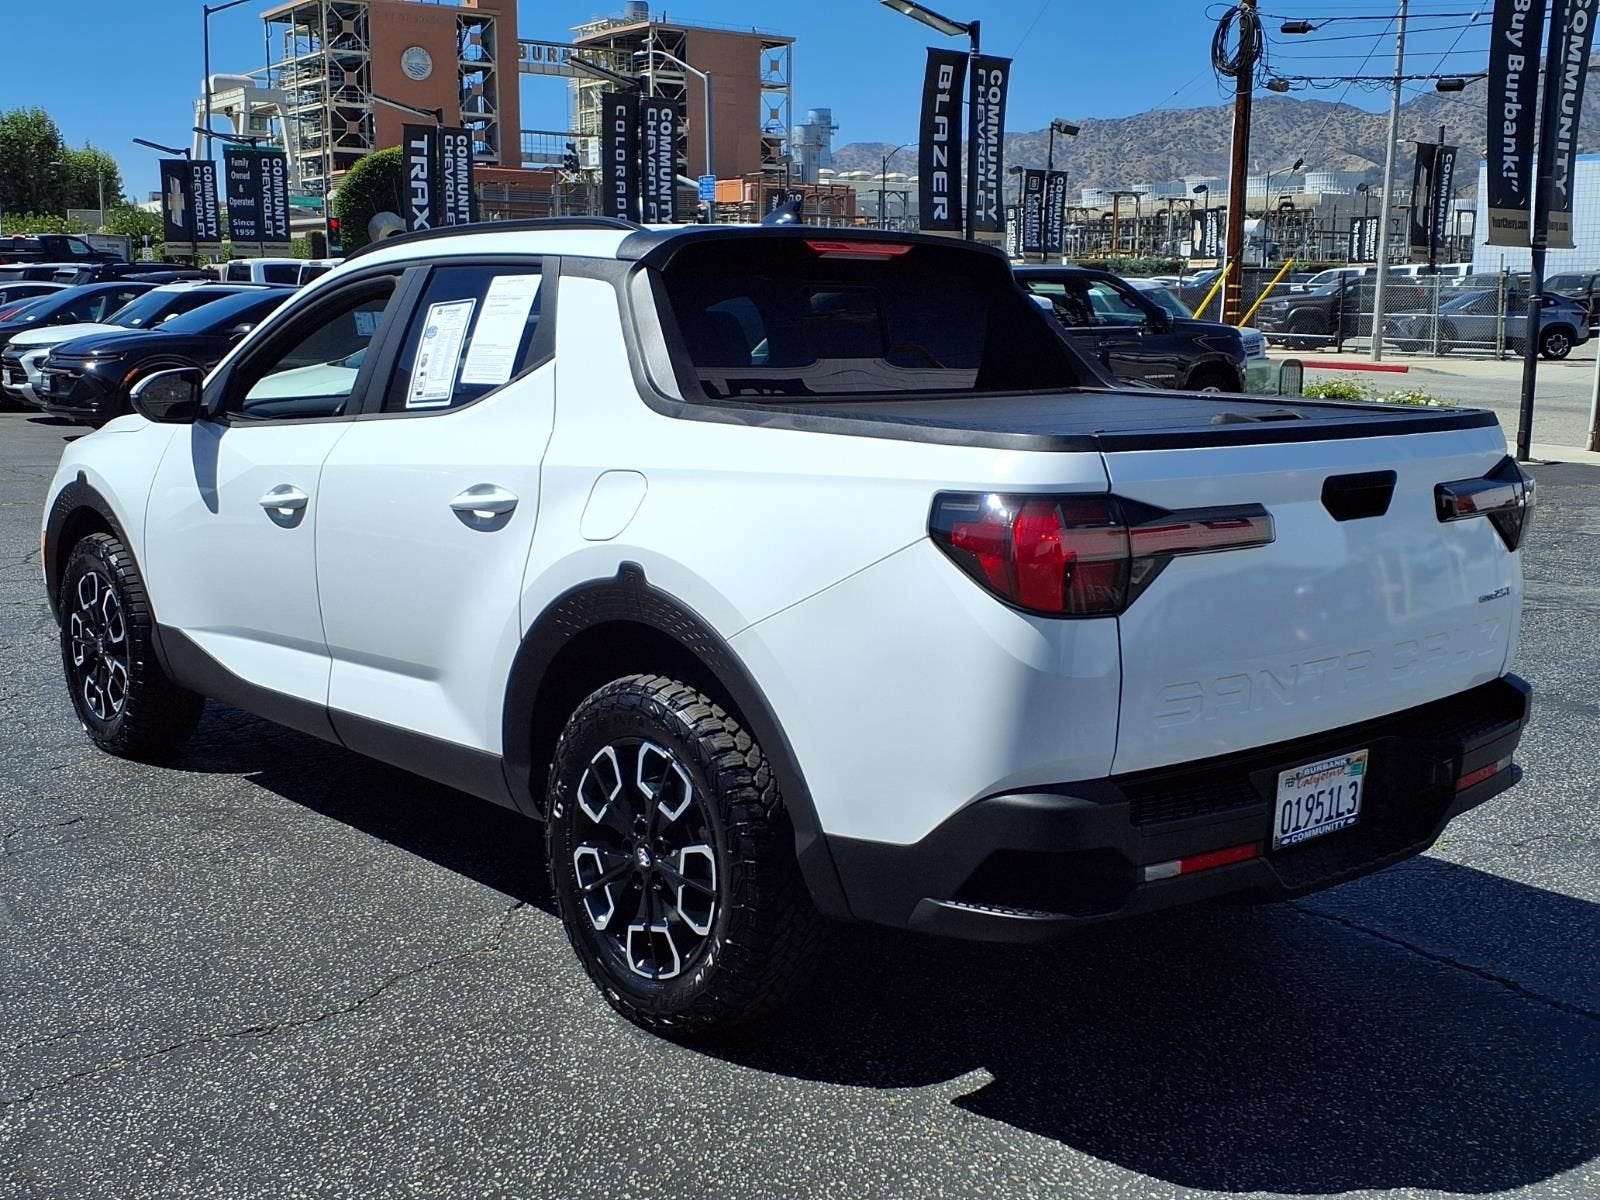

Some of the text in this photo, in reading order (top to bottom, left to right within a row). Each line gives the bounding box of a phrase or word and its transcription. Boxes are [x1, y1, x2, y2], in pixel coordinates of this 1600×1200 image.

[230, 170, 251, 180] Owned
[231, 157, 249, 168] Family
[659, 108, 673, 224] COMMUNITY
[933, 63, 954, 220] BLAZER
[987, 69, 1003, 222] COMMUNITY
[193, 166, 206, 238] CHEVROLET
[203, 165, 218, 237] COMMUNITY
[229, 197, 255, 208] Operated
[261, 158, 274, 237] CHEVROLET
[272, 158, 287, 237] COMMUNITY
[410, 134, 431, 230] TRAX
[444, 135, 456, 225] CHEVROLE
[456, 135, 470, 224] COMMUNIT
[1052, 177, 1064, 248] COMMUNITY
[1437, 153, 1453, 241] COMMUNITY
[232, 218, 255, 226] Since
[235, 228, 255, 236] 1959
[1210, 211, 1218, 257] COMMUNITY
[1369, 218, 1378, 260] COMMUNITY
[1304, 758, 1347, 775] BURBANK
[1281, 780, 1358, 835] 01951L3
[1291, 819, 1346, 843] COMMUNITY
